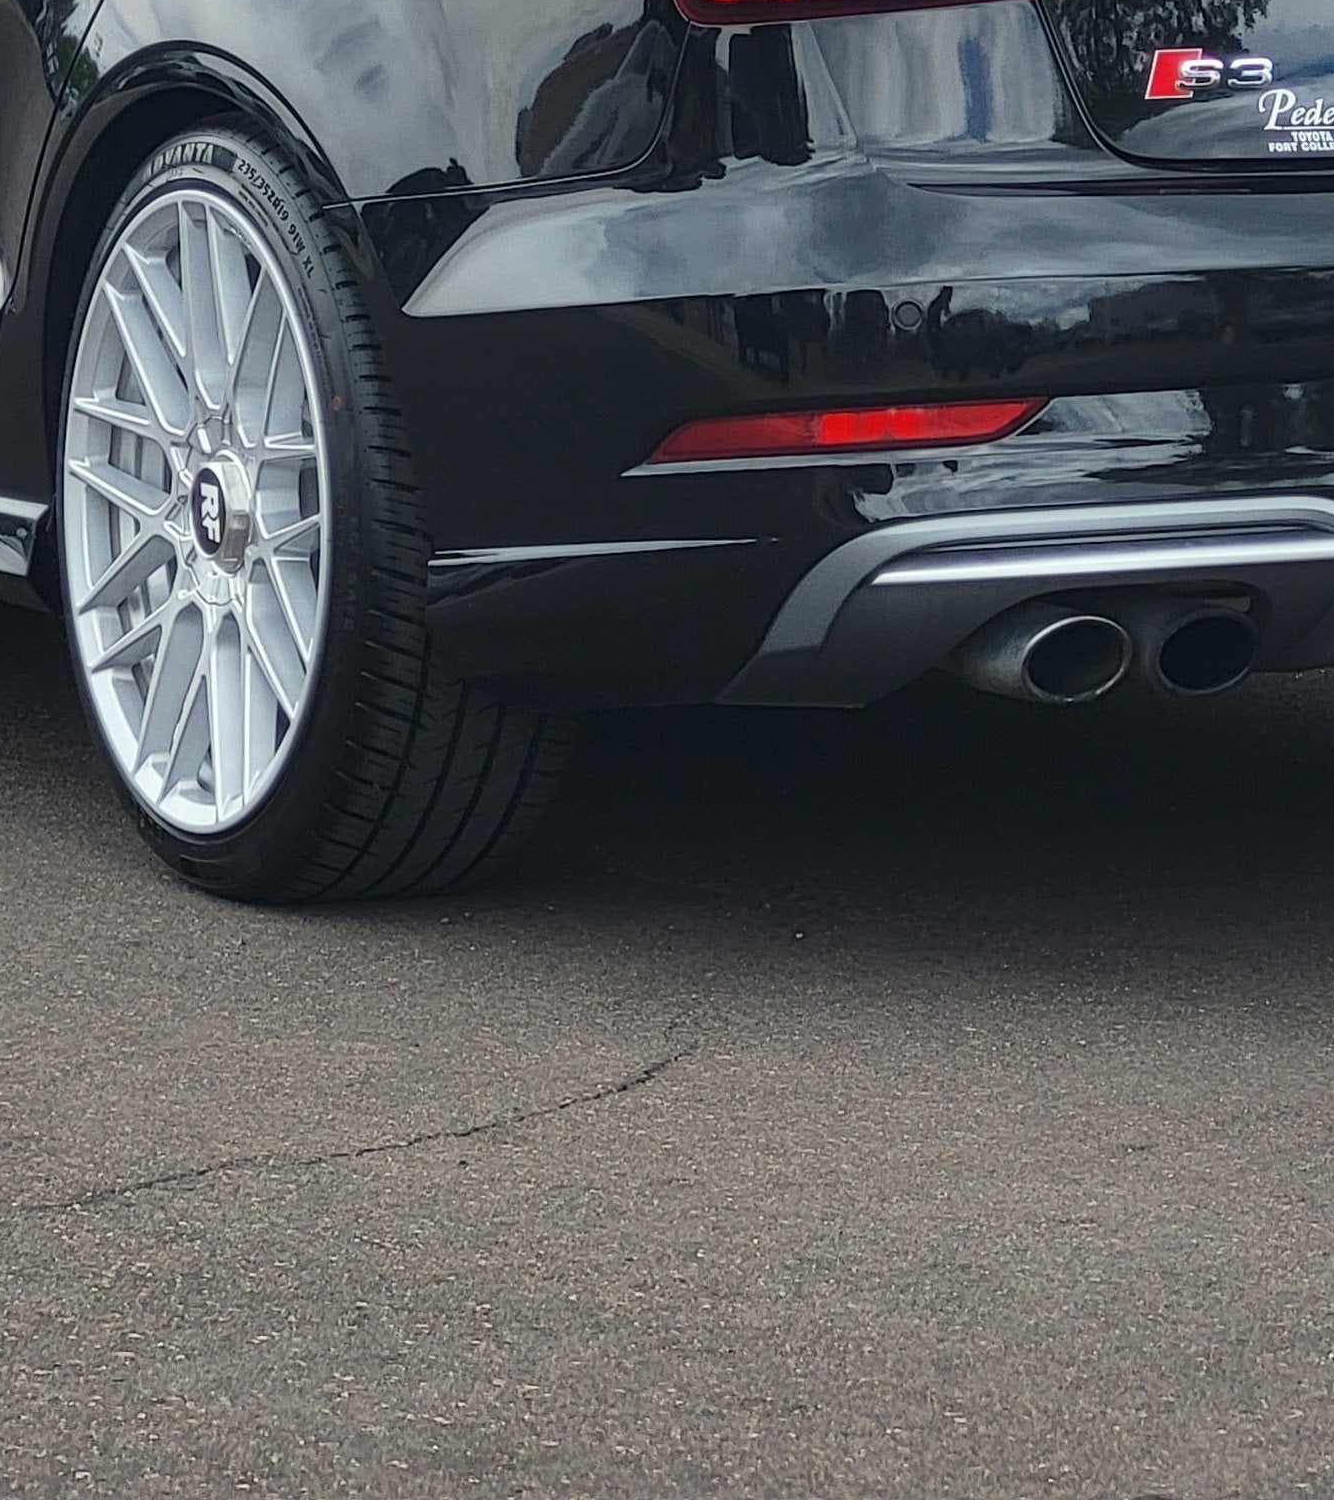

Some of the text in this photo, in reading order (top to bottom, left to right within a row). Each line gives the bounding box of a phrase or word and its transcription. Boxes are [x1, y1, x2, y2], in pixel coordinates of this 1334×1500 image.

[1174, 57, 1274, 88] S3
[1268, 141, 1298, 153] FORT
[1291, 131, 1334, 142] TOYOTA
[302, 256, 316, 279] XL
[200, 482, 221, 544] RF
